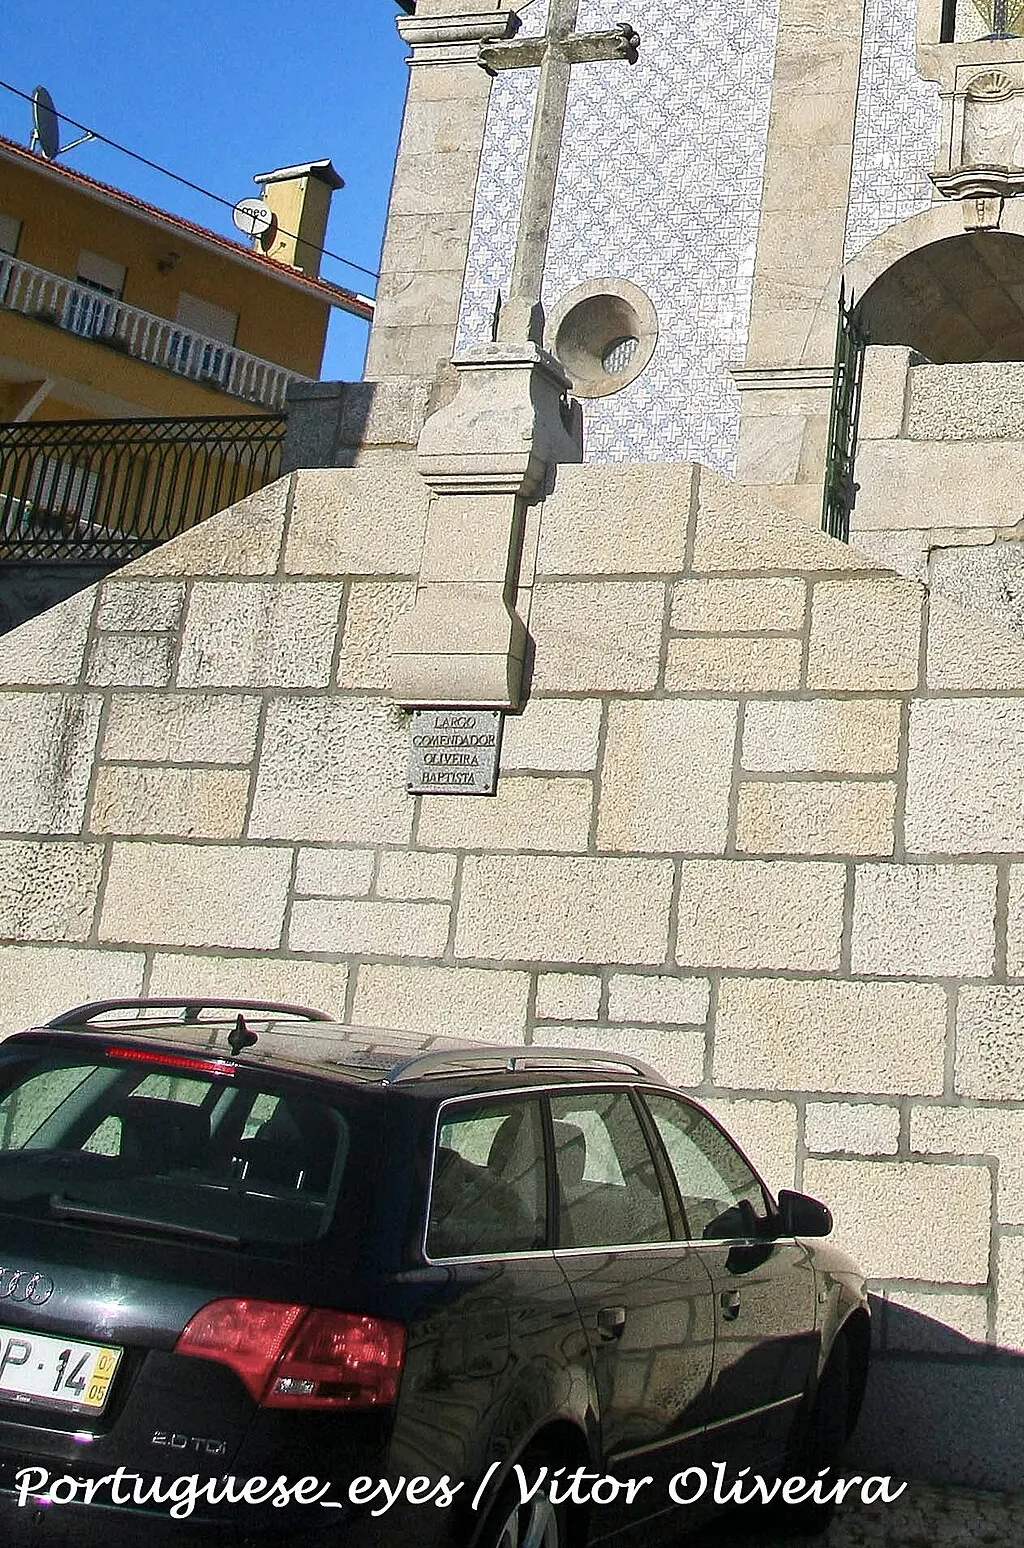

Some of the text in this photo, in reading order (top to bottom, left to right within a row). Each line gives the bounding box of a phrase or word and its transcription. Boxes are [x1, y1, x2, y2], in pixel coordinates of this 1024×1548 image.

[242, 207, 267, 217] meo
[434, 717, 476, 728] LARGO
[412, 734, 496, 747] COMENDADOR
[423, 753, 479, 766] OLIVEIRA
[420, 772, 476, 785] BAPTISTA
[89, 1385, 106, 1401] 05
